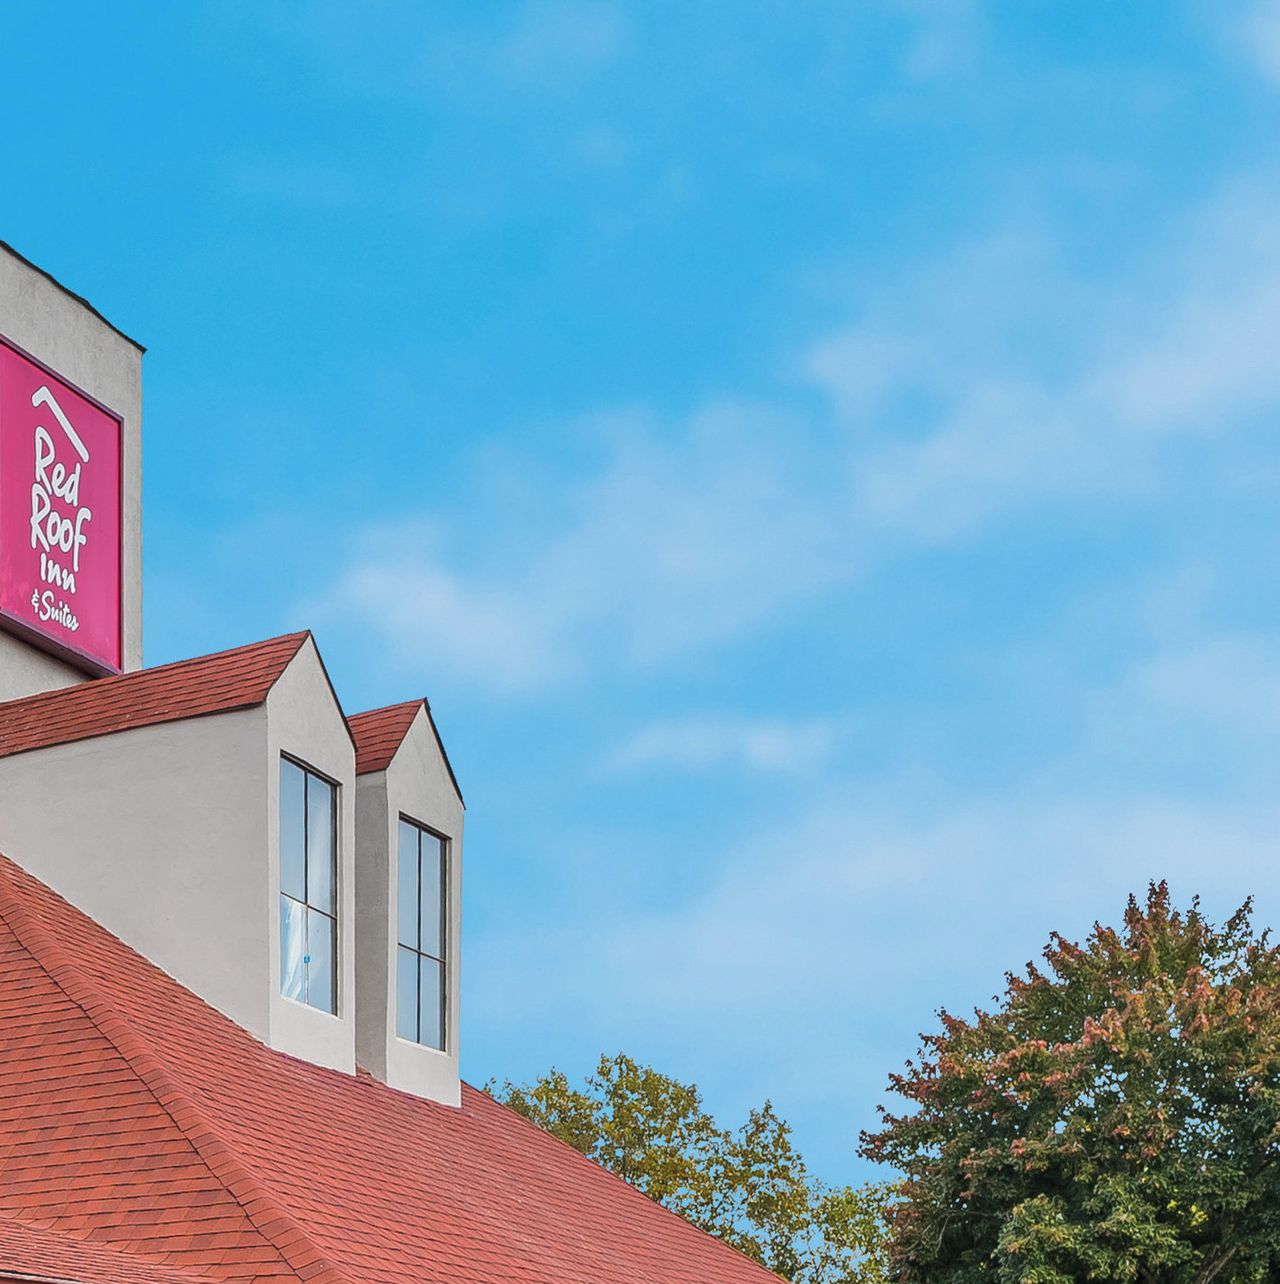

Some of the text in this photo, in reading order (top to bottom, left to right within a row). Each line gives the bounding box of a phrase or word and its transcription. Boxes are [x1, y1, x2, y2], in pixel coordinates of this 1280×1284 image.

[35, 426, 81, 507] Red
[29, 482, 91, 573] Roof
[39, 590, 79, 631] Suites
